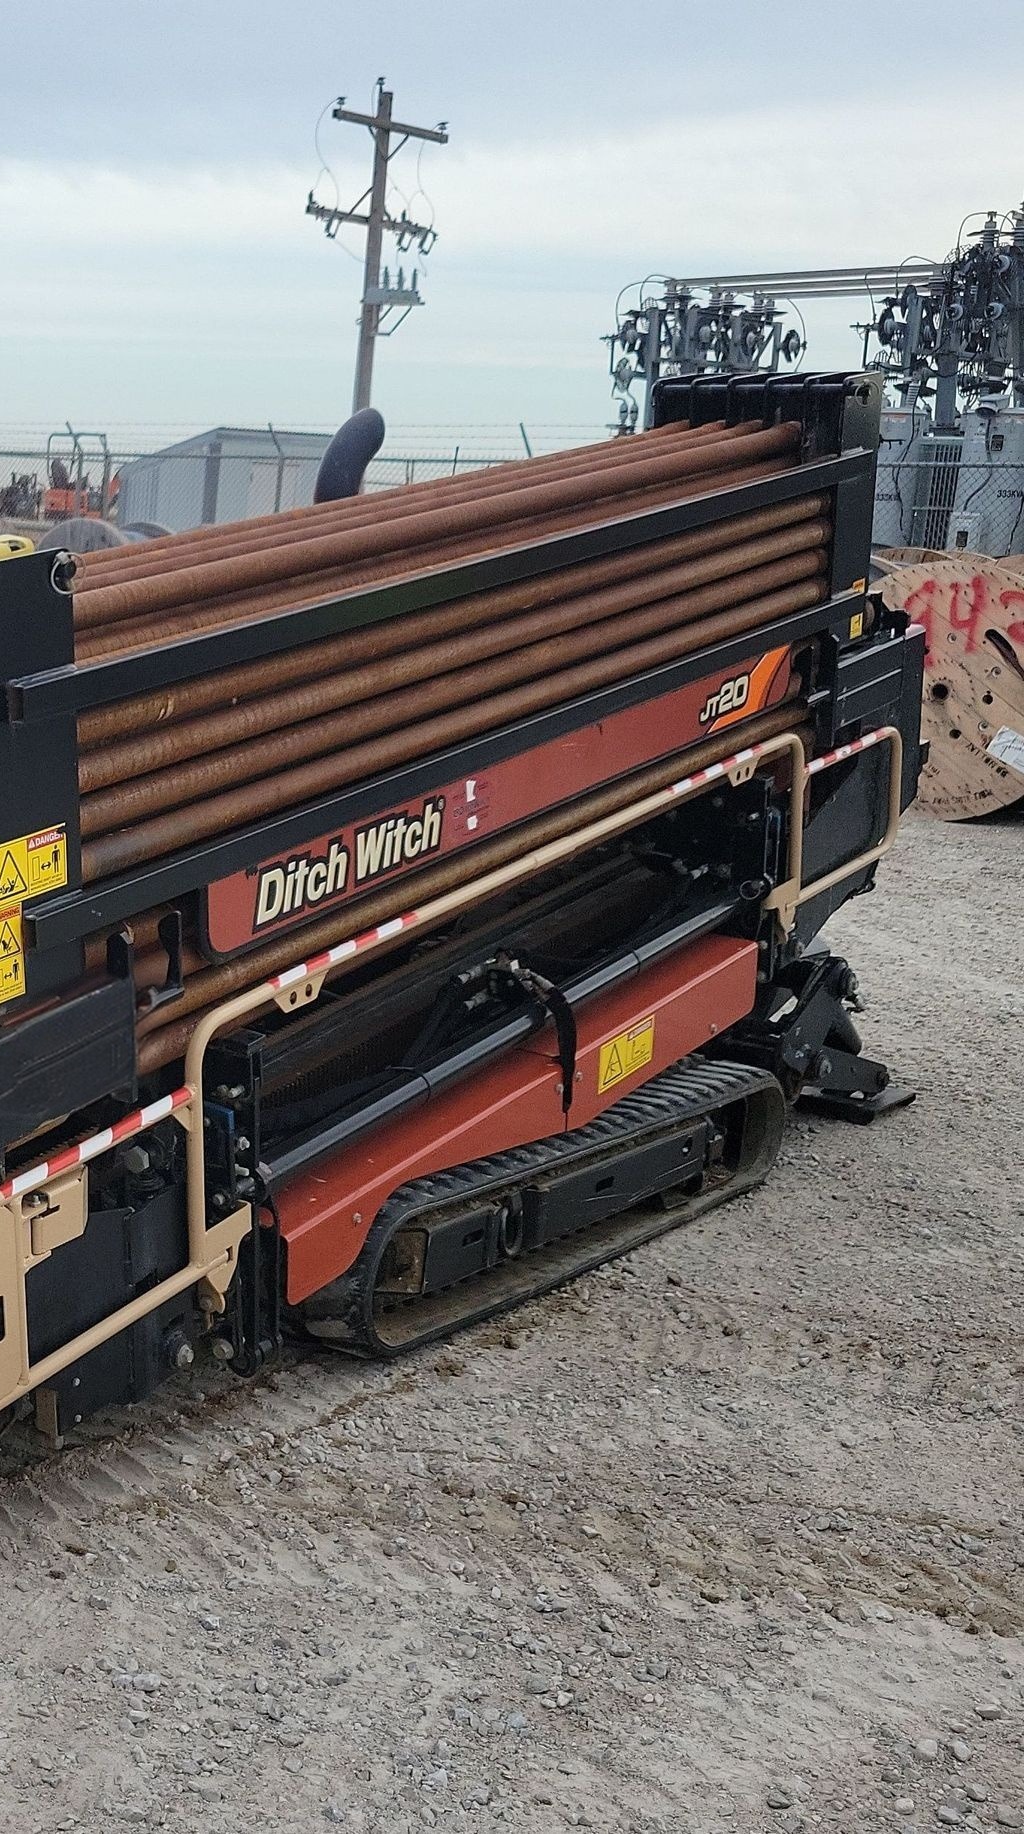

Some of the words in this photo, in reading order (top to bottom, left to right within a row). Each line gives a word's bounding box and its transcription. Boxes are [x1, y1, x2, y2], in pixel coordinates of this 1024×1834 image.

[699, 674, 749, 722] JT20
[256, 843, 349, 926] Ditch
[356, 802, 443, 880] Witch
